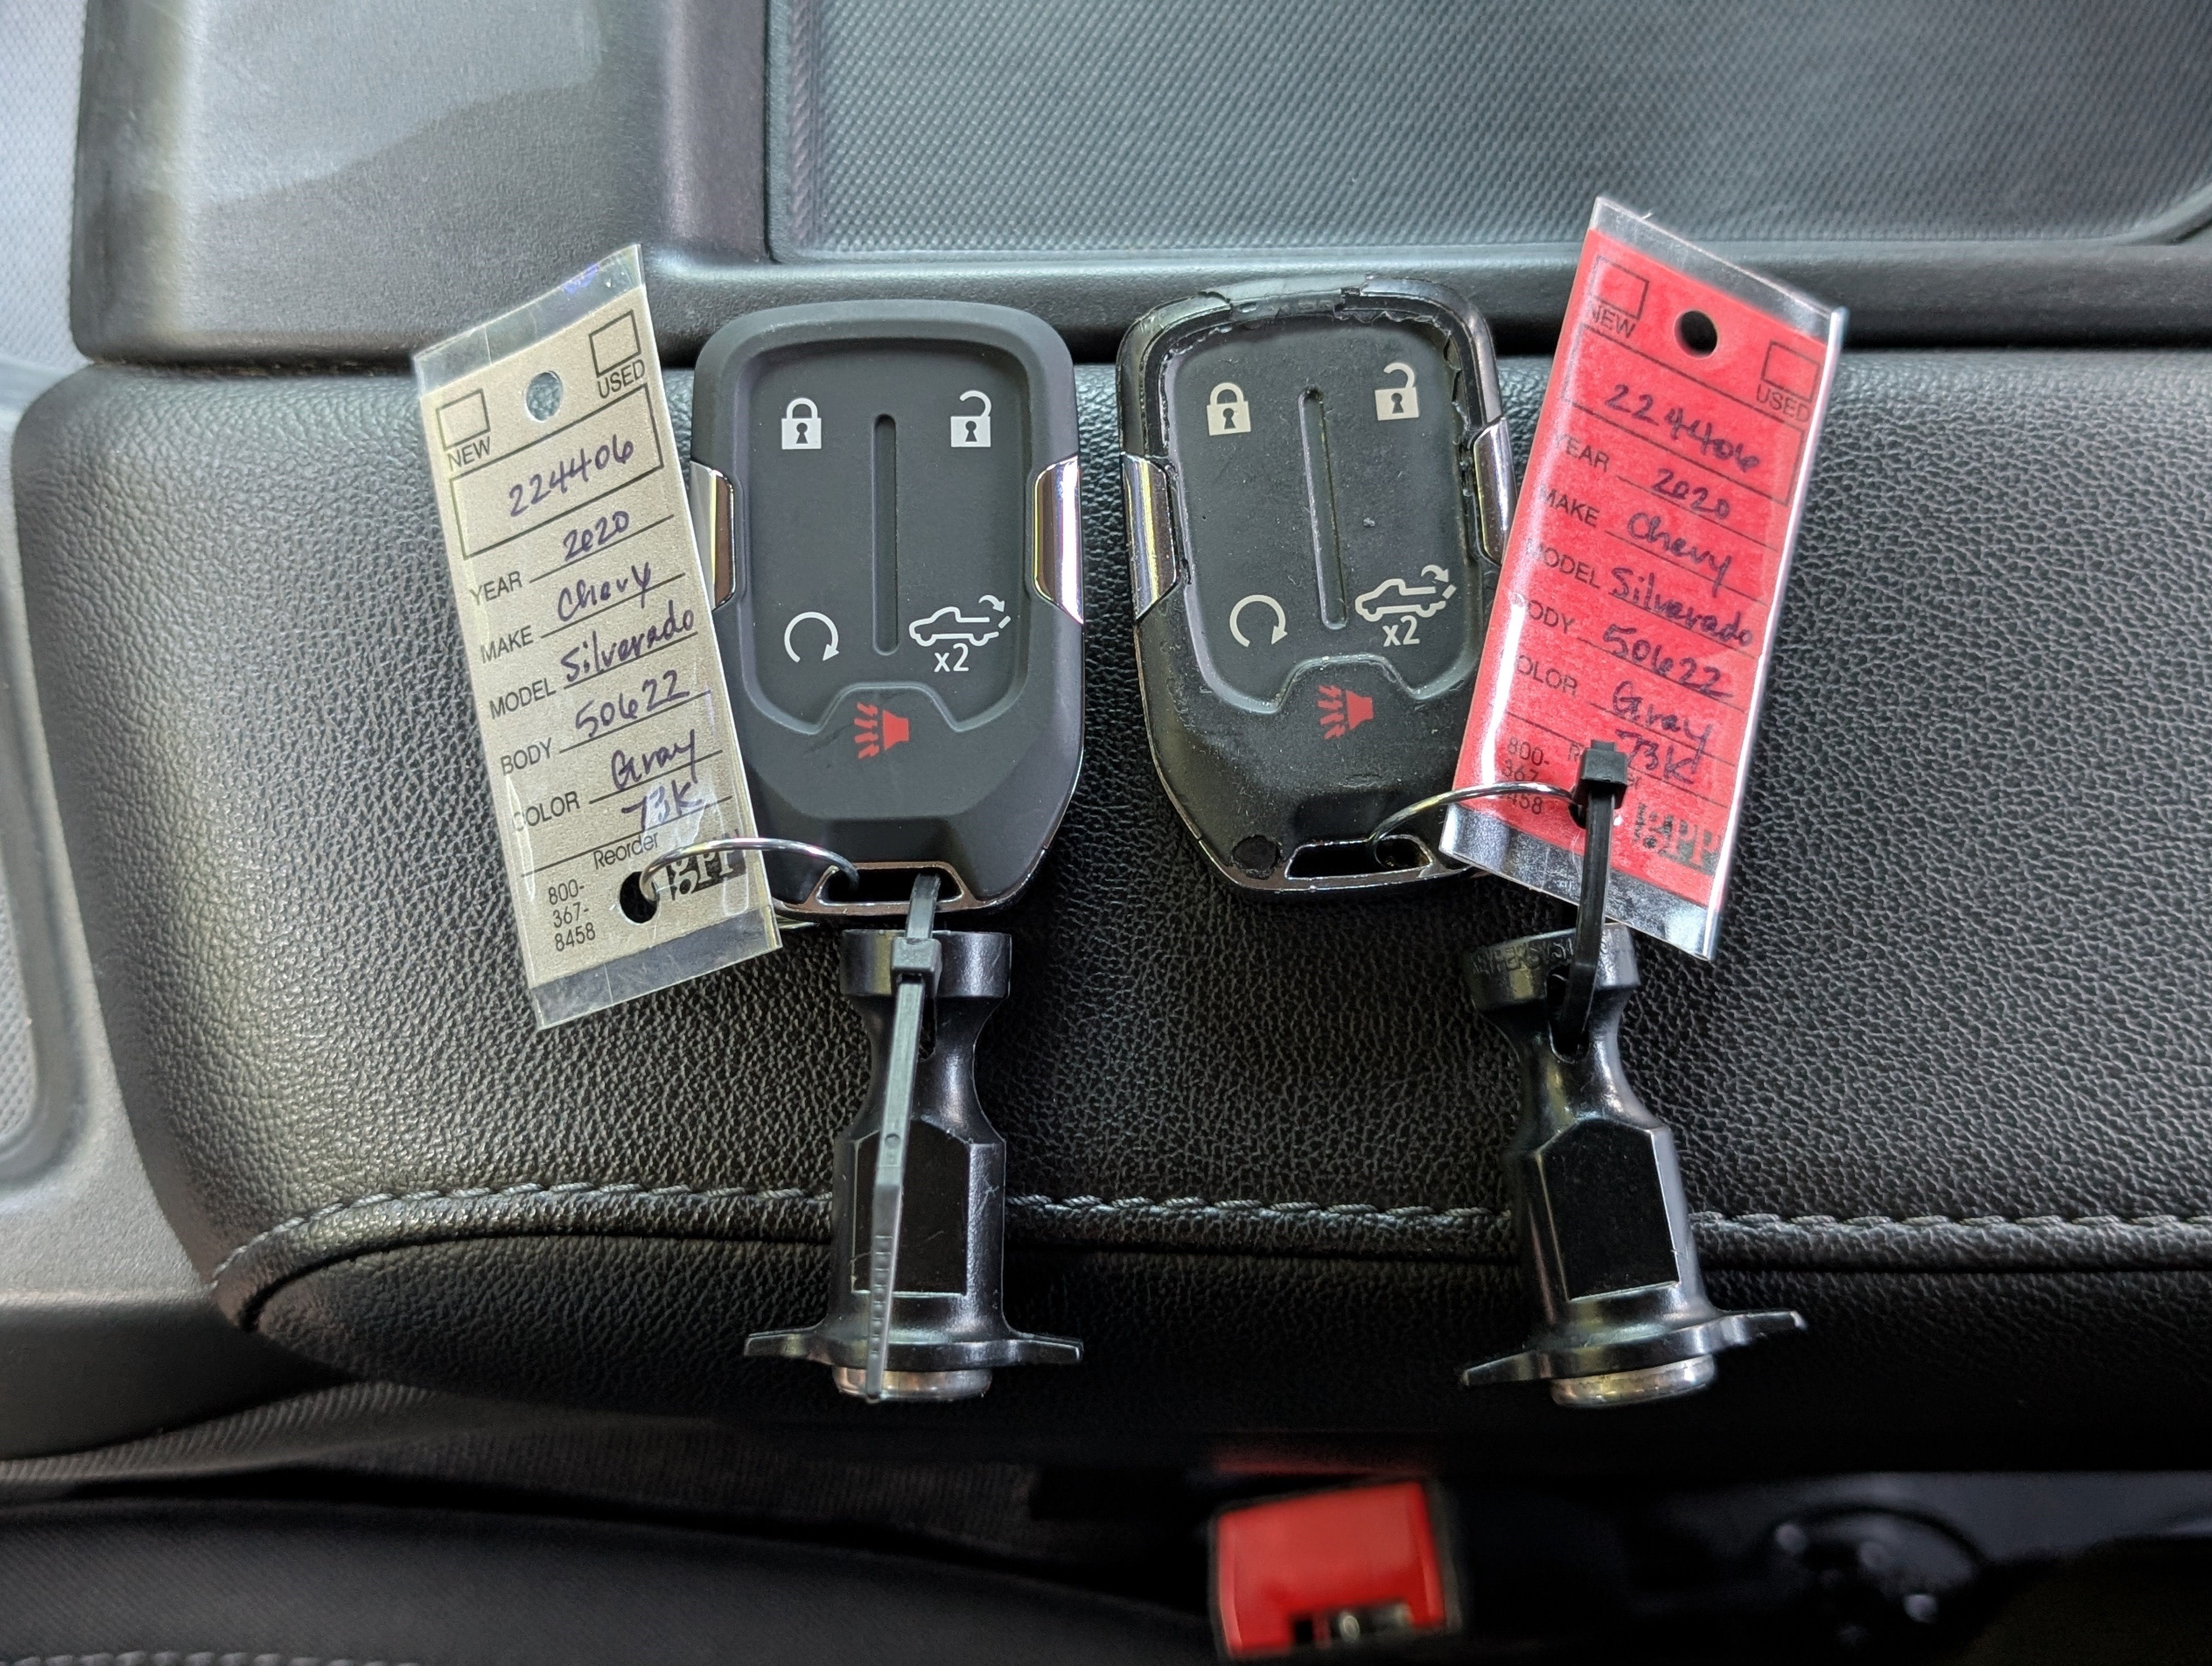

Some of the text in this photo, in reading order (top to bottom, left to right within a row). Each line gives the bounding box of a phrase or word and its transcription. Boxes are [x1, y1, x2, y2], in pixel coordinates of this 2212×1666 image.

[1589, 302, 1636, 338] NEW
[597, 359, 645, 399] USED
[1756, 384, 1810, 423] USED
[1605, 383, 1760, 473] 224406
[447, 435, 491, 470] NEW
[1554, 428, 1610, 472] YEAR
[510, 434, 634, 517] 224406
[1651, 468, 1729, 520] 2020
[1539, 484, 1600, 528] MAKE
[563, 510, 629, 562] 2020
[1628, 512, 1733, 598] Chevy
[470, 571, 523, 606] YEAR
[558, 562, 651, 622] Chevy
[1612, 567, 1753, 646] Silverado
[480, 625, 533, 663] MAKE
[561, 599, 694, 682] Silverado
[1382, 615, 1420, 647] x2
[934, 643, 969, 672] x2
[1502, 650, 1578, 697] OLOR
[1603, 624, 1733, 698] 50622
[489, 678, 556, 720] MODEL
[576, 669, 690, 738] 50622
[1612, 680, 1713, 774] Gray
[500, 737, 552, 776] BODY
[612, 728, 698, 791] Gray
[1501, 759, 1539, 782] 367
[1507, 736, 1549, 766] 800-
[1615, 729, 1694, 785] 73K
[511, 791, 580, 832] COLOR
[1499, 793, 1542, 815] 458
[593, 832, 658, 870] Reorder
[548, 879, 584, 905] 800-
[552, 901, 589, 928] 367-
[555, 922, 596, 952] 8458
